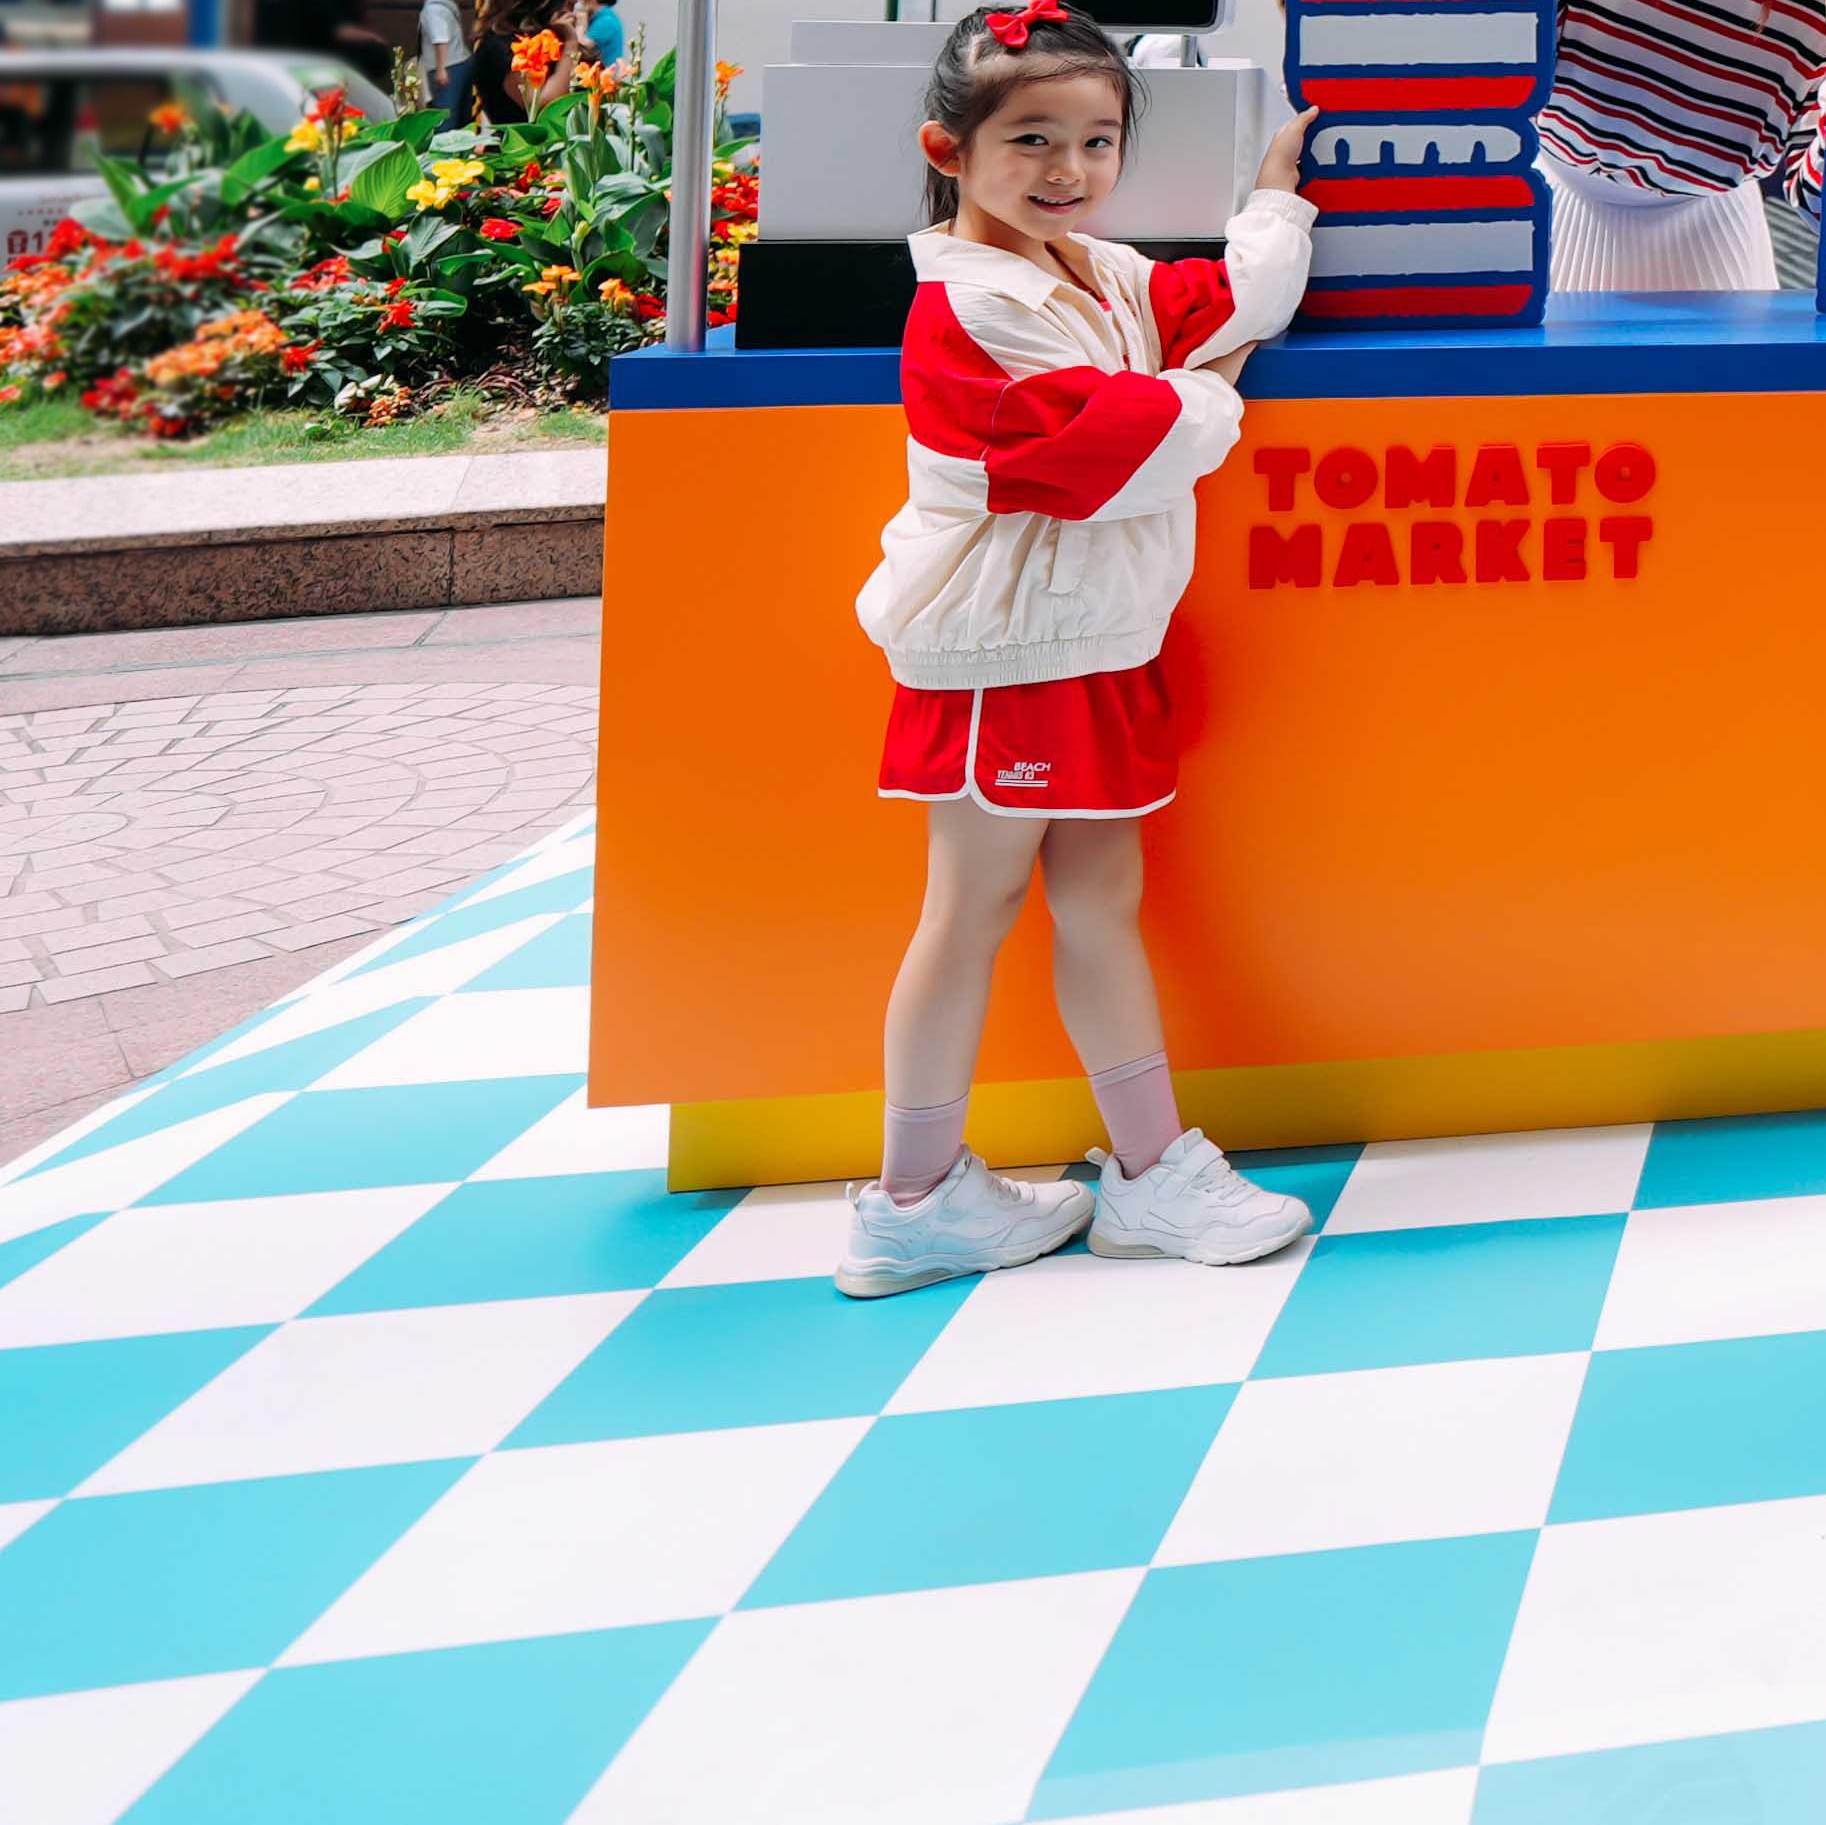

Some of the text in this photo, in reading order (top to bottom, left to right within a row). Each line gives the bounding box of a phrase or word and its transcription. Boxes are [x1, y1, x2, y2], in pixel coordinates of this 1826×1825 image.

[1254, 440, 1656, 511] TOMATO
[1248, 517, 1653, 590] MARKET
[1013, 761, 1051, 772] BEACH
